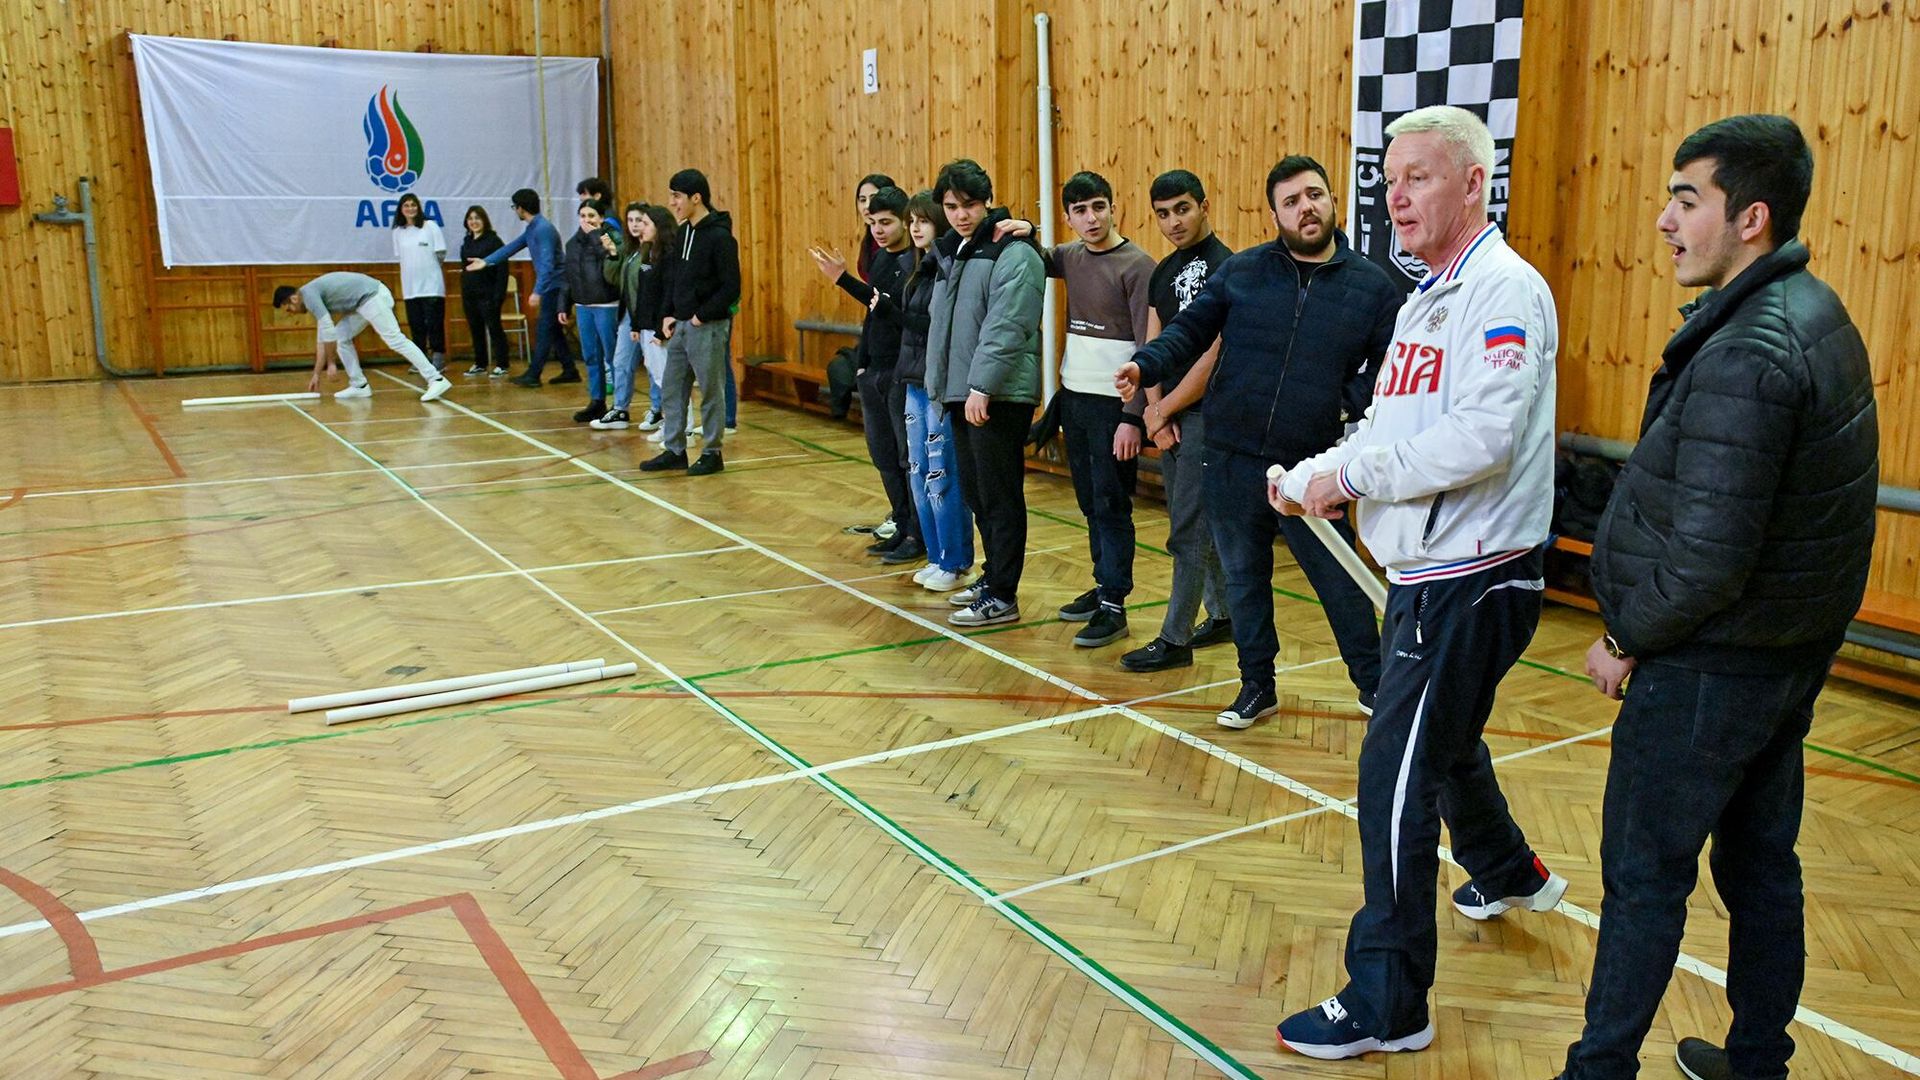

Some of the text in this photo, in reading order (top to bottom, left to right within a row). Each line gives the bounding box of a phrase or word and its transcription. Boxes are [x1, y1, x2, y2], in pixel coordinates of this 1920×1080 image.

[866, 63, 875, 88] 3
[355, 199, 445, 228] AFA
[1376, 341, 1445, 397] SIA
[1483, 348, 1528, 366] NATIONAL
[1491, 358, 1521, 371] TEAM
